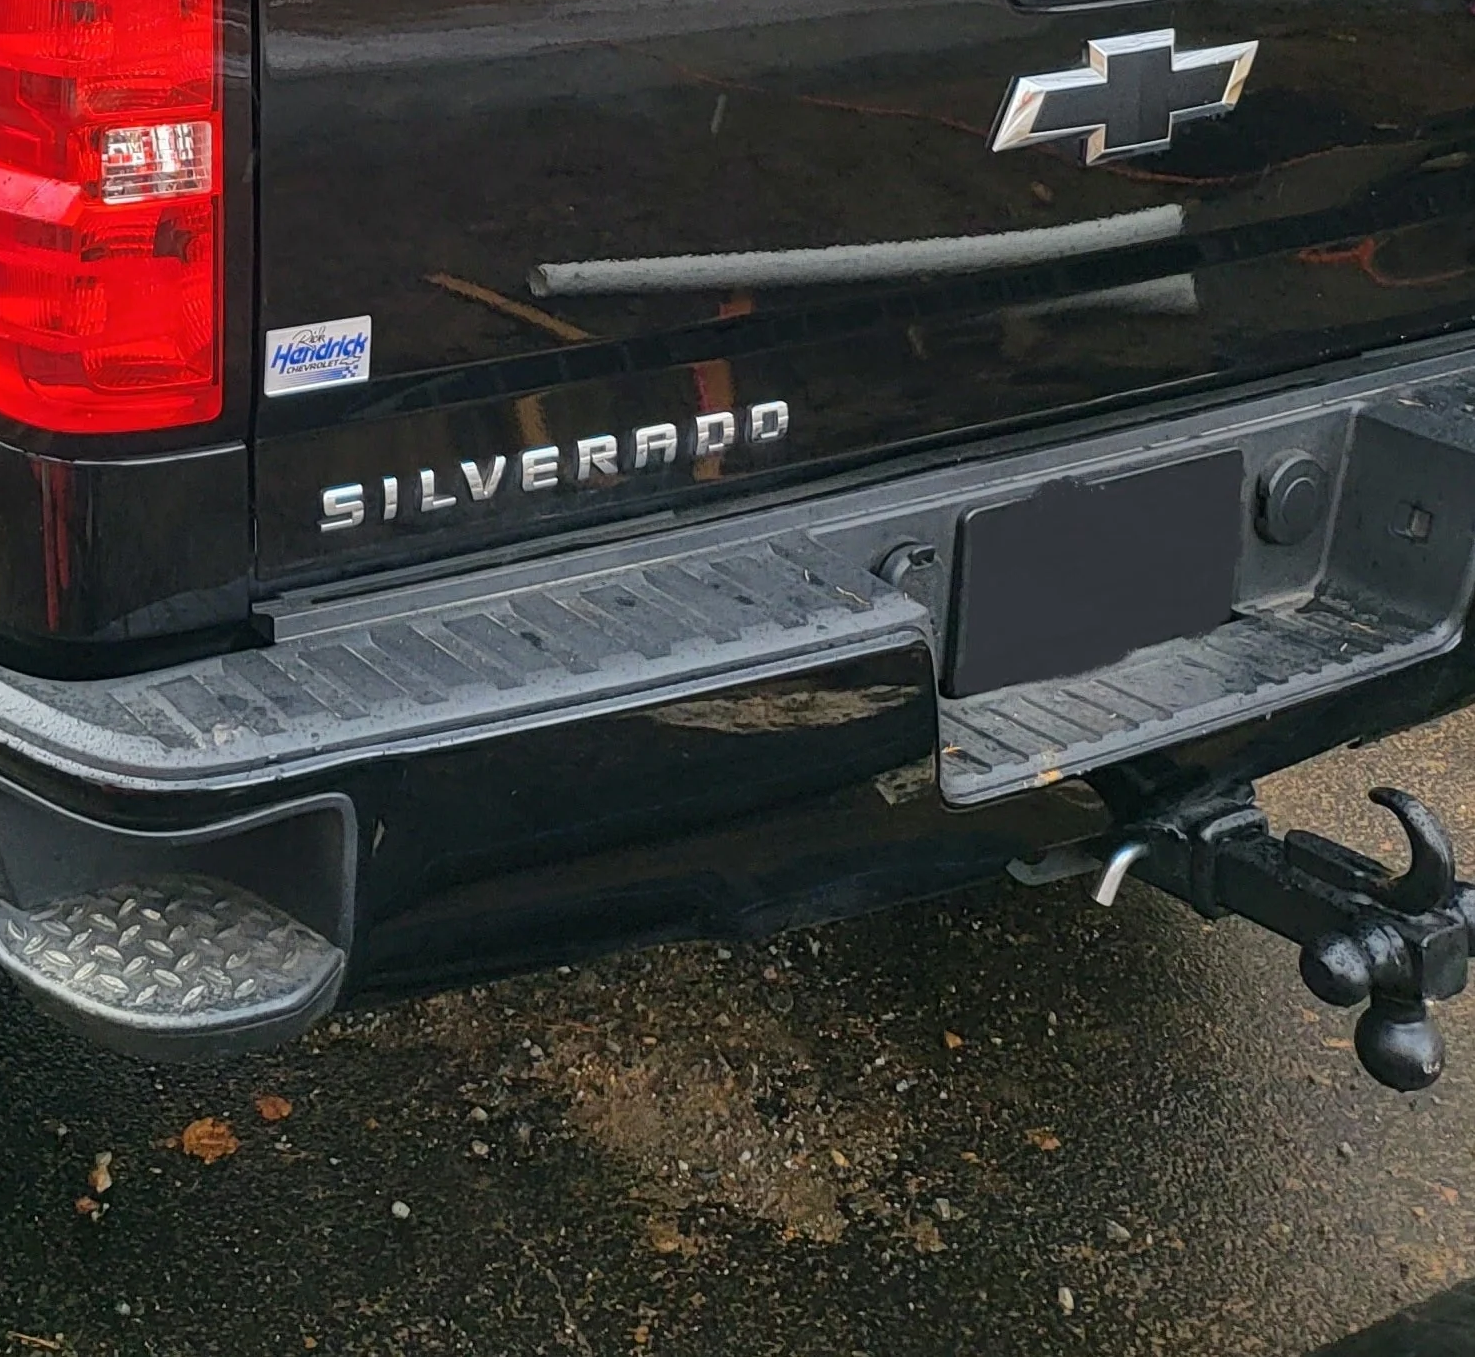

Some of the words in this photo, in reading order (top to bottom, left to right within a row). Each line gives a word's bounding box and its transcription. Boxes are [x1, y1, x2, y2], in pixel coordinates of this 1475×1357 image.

[270, 331, 368, 375] Hendrick
[286, 358, 340, 375] CHEVROLET
[319, 400, 790, 533] SILVERADO
